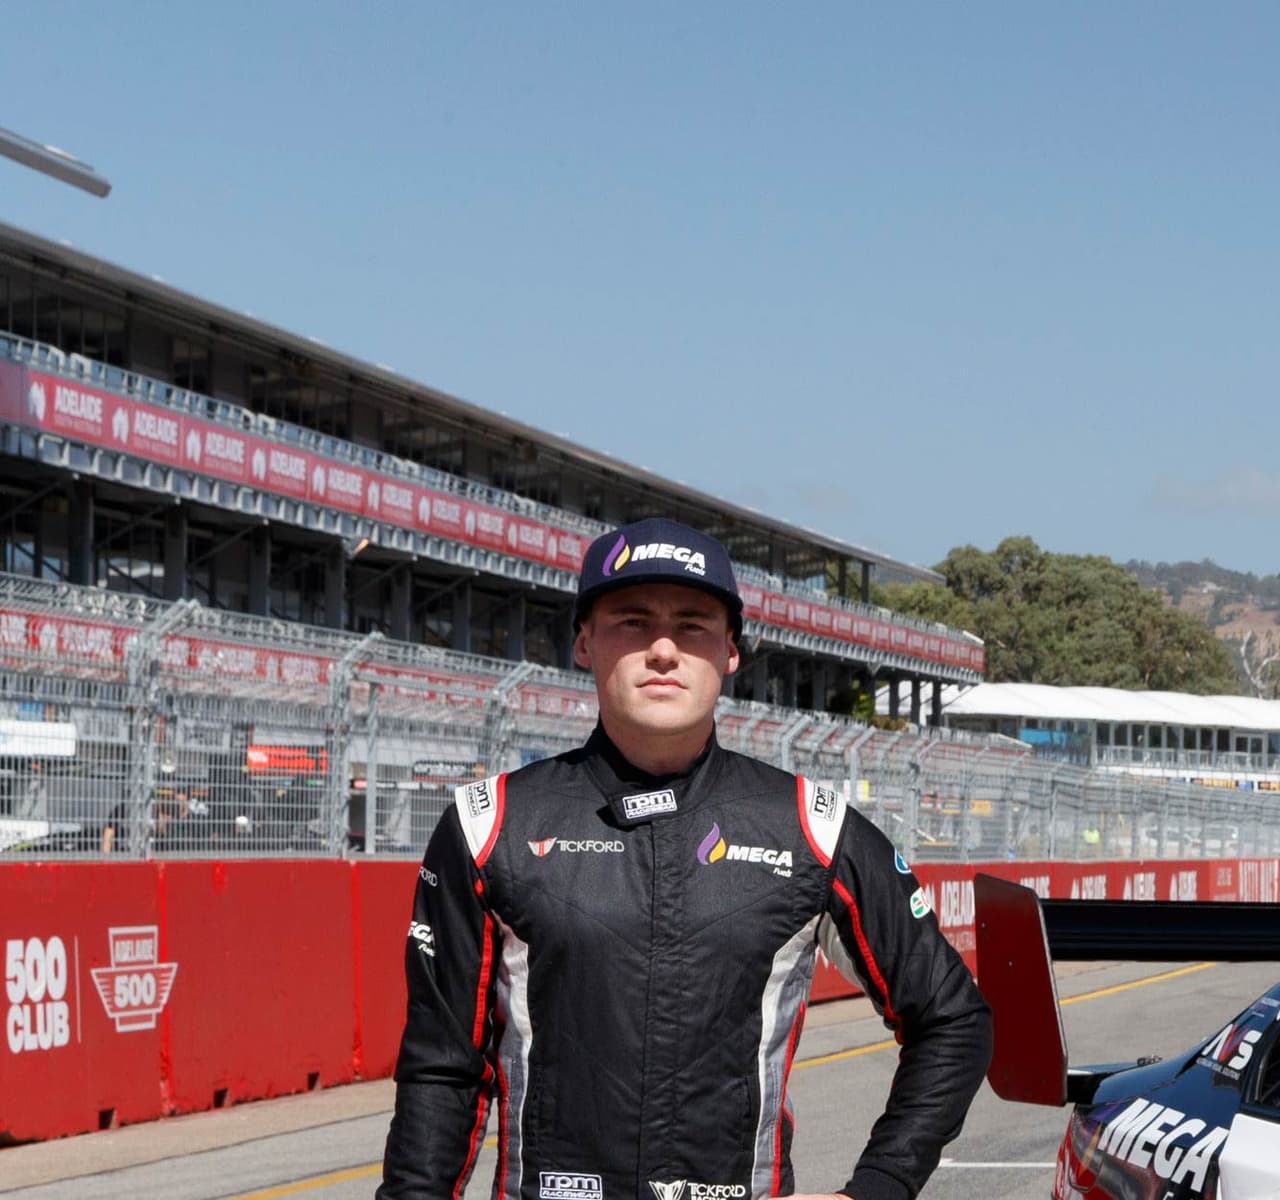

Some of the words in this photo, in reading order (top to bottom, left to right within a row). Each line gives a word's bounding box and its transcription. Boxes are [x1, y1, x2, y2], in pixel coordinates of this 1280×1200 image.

[54, 386, 103, 423] ADELAIDE
[134, 411, 179, 446] ADELAIDE
[205, 431, 244, 464] ADELAIDE
[270, 450, 306, 480] ADELAIDE
[631, 543, 706, 569] MEGA
[557, 840, 624, 853] TICKFORD
[726, 845, 793, 867] MEGA
[6, 936, 67, 1004] 500
[114, 973, 156, 1008] 500
[7, 1000, 70, 1054] CLUB
[1098, 1098, 1230, 1192] MEGA
[543, 1190, 600, 1199] RACEWEAR
[545, 1176, 599, 1191] rpm
[688, 1182, 746, 1198] TICKFORD
